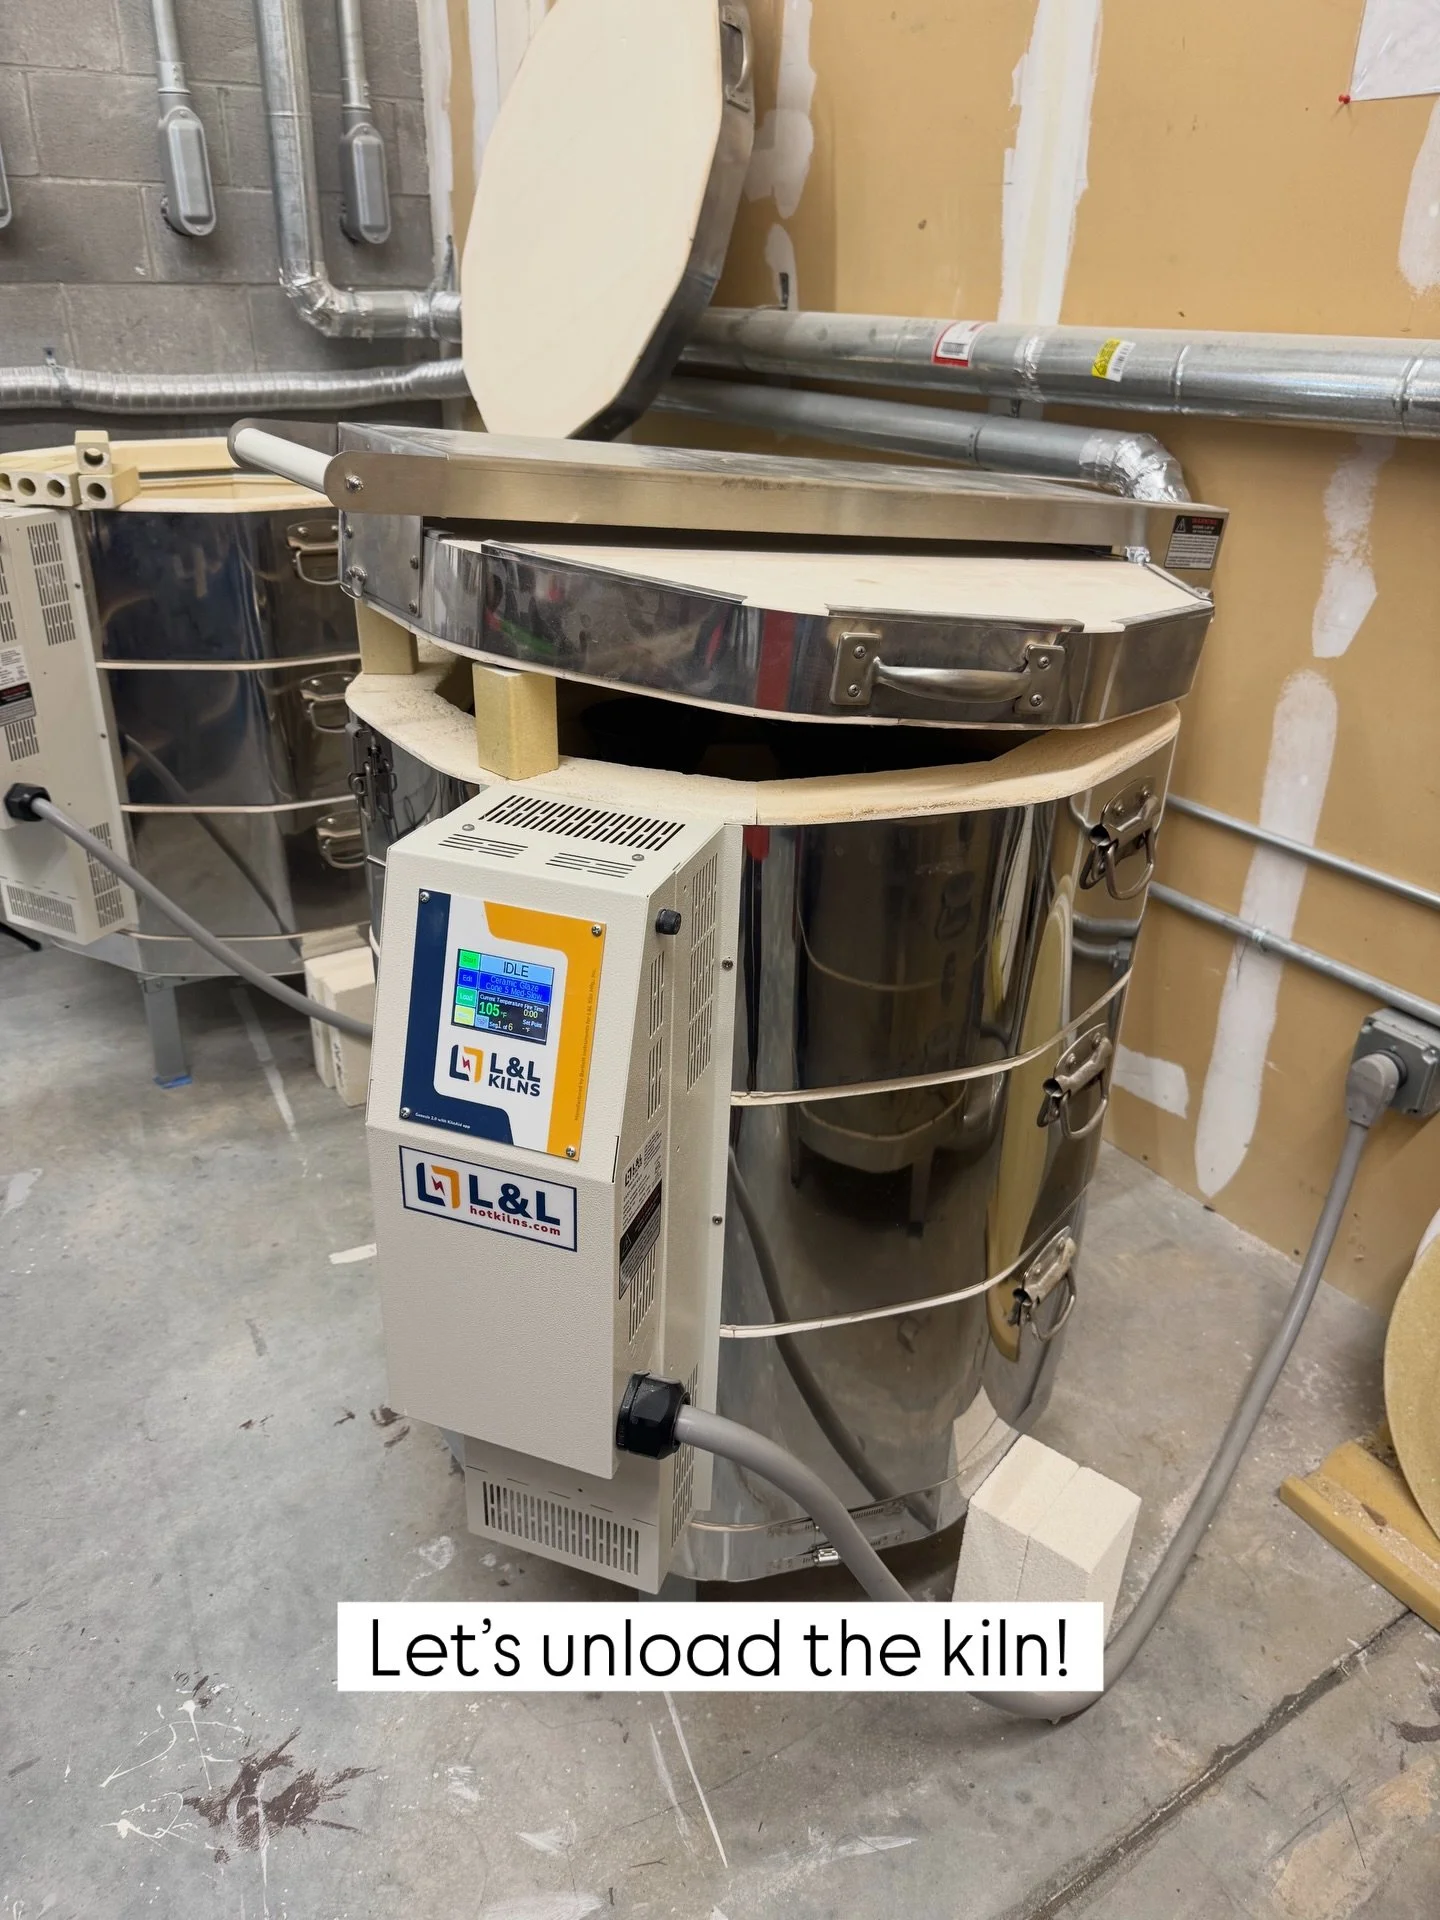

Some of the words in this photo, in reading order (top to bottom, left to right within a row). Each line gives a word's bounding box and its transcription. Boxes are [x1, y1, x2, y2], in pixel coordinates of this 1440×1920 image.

[503, 961, 529, 978] IDLE
[462, 975, 473, 983] Edit
[491, 975, 518, 988] Ceramic
[520, 981, 539, 992] Glaze
[486, 982, 501, 992] Cone
[511, 988, 543, 1000] Med-Slow
[479, 1002, 500, 1017] 105
[480, 994, 496, 1002] Current
[497, 997, 524, 1008] Temperature
[523, 1008, 539, 1018] 0:00
[508, 1022, 513, 1031] 6
[531, 1021, 543, 1029] Point
[490, 1052, 541, 1083] L&L
[488, 1074, 540, 1097] KILNS
[469, 1174, 560, 1226] L&L
[470, 1205, 561, 1236] hotkilns.com
